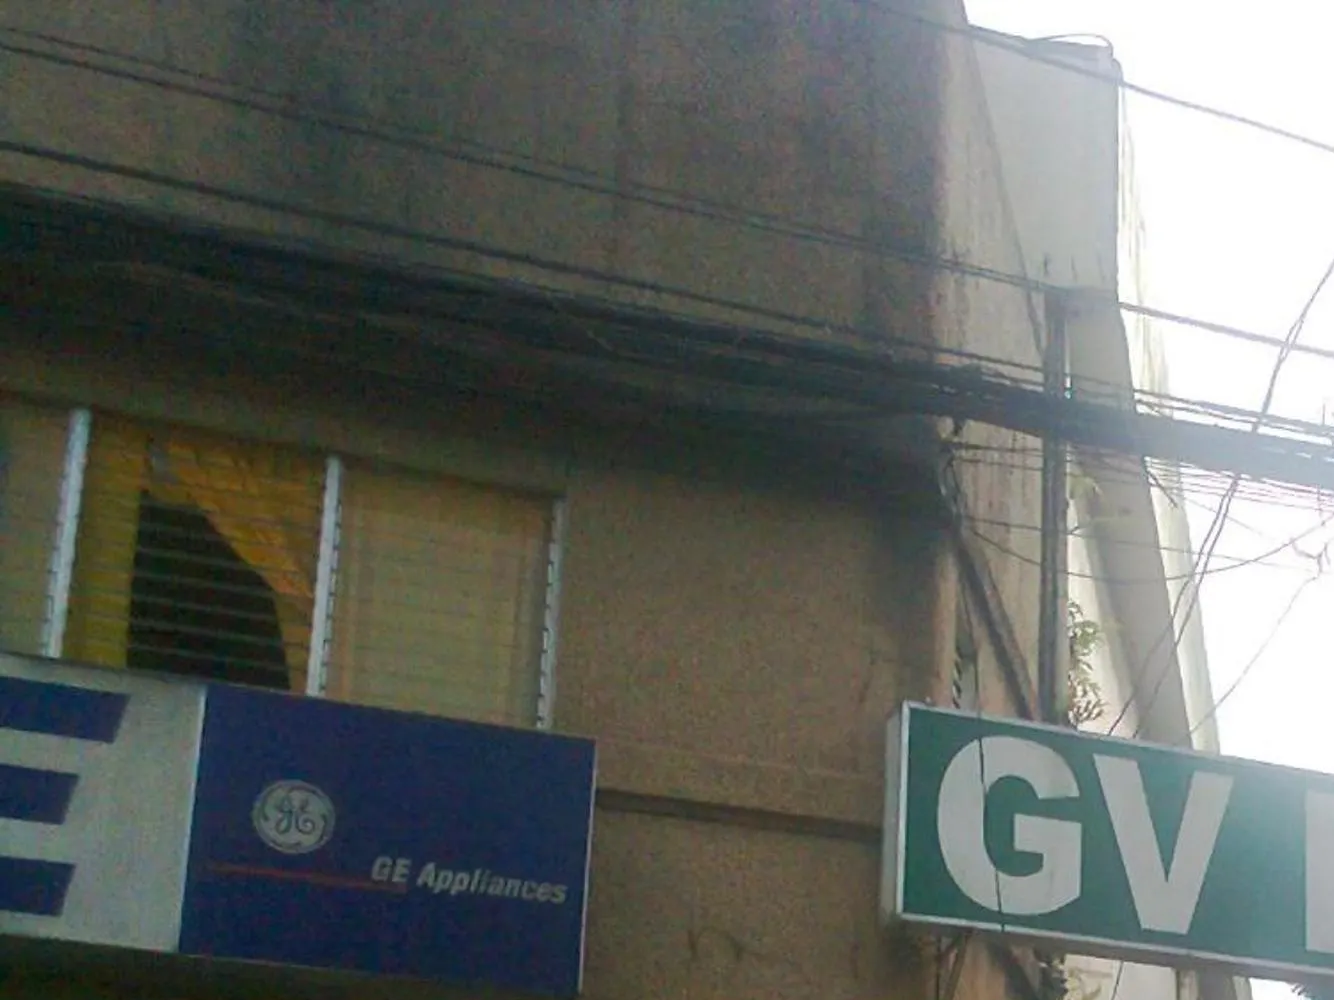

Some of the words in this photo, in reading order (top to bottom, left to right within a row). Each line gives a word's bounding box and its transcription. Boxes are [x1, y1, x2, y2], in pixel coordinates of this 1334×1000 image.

[371, 856, 411, 883] GE
[415, 861, 569, 905] Appliances
[938, 735, 1234, 936] GV
